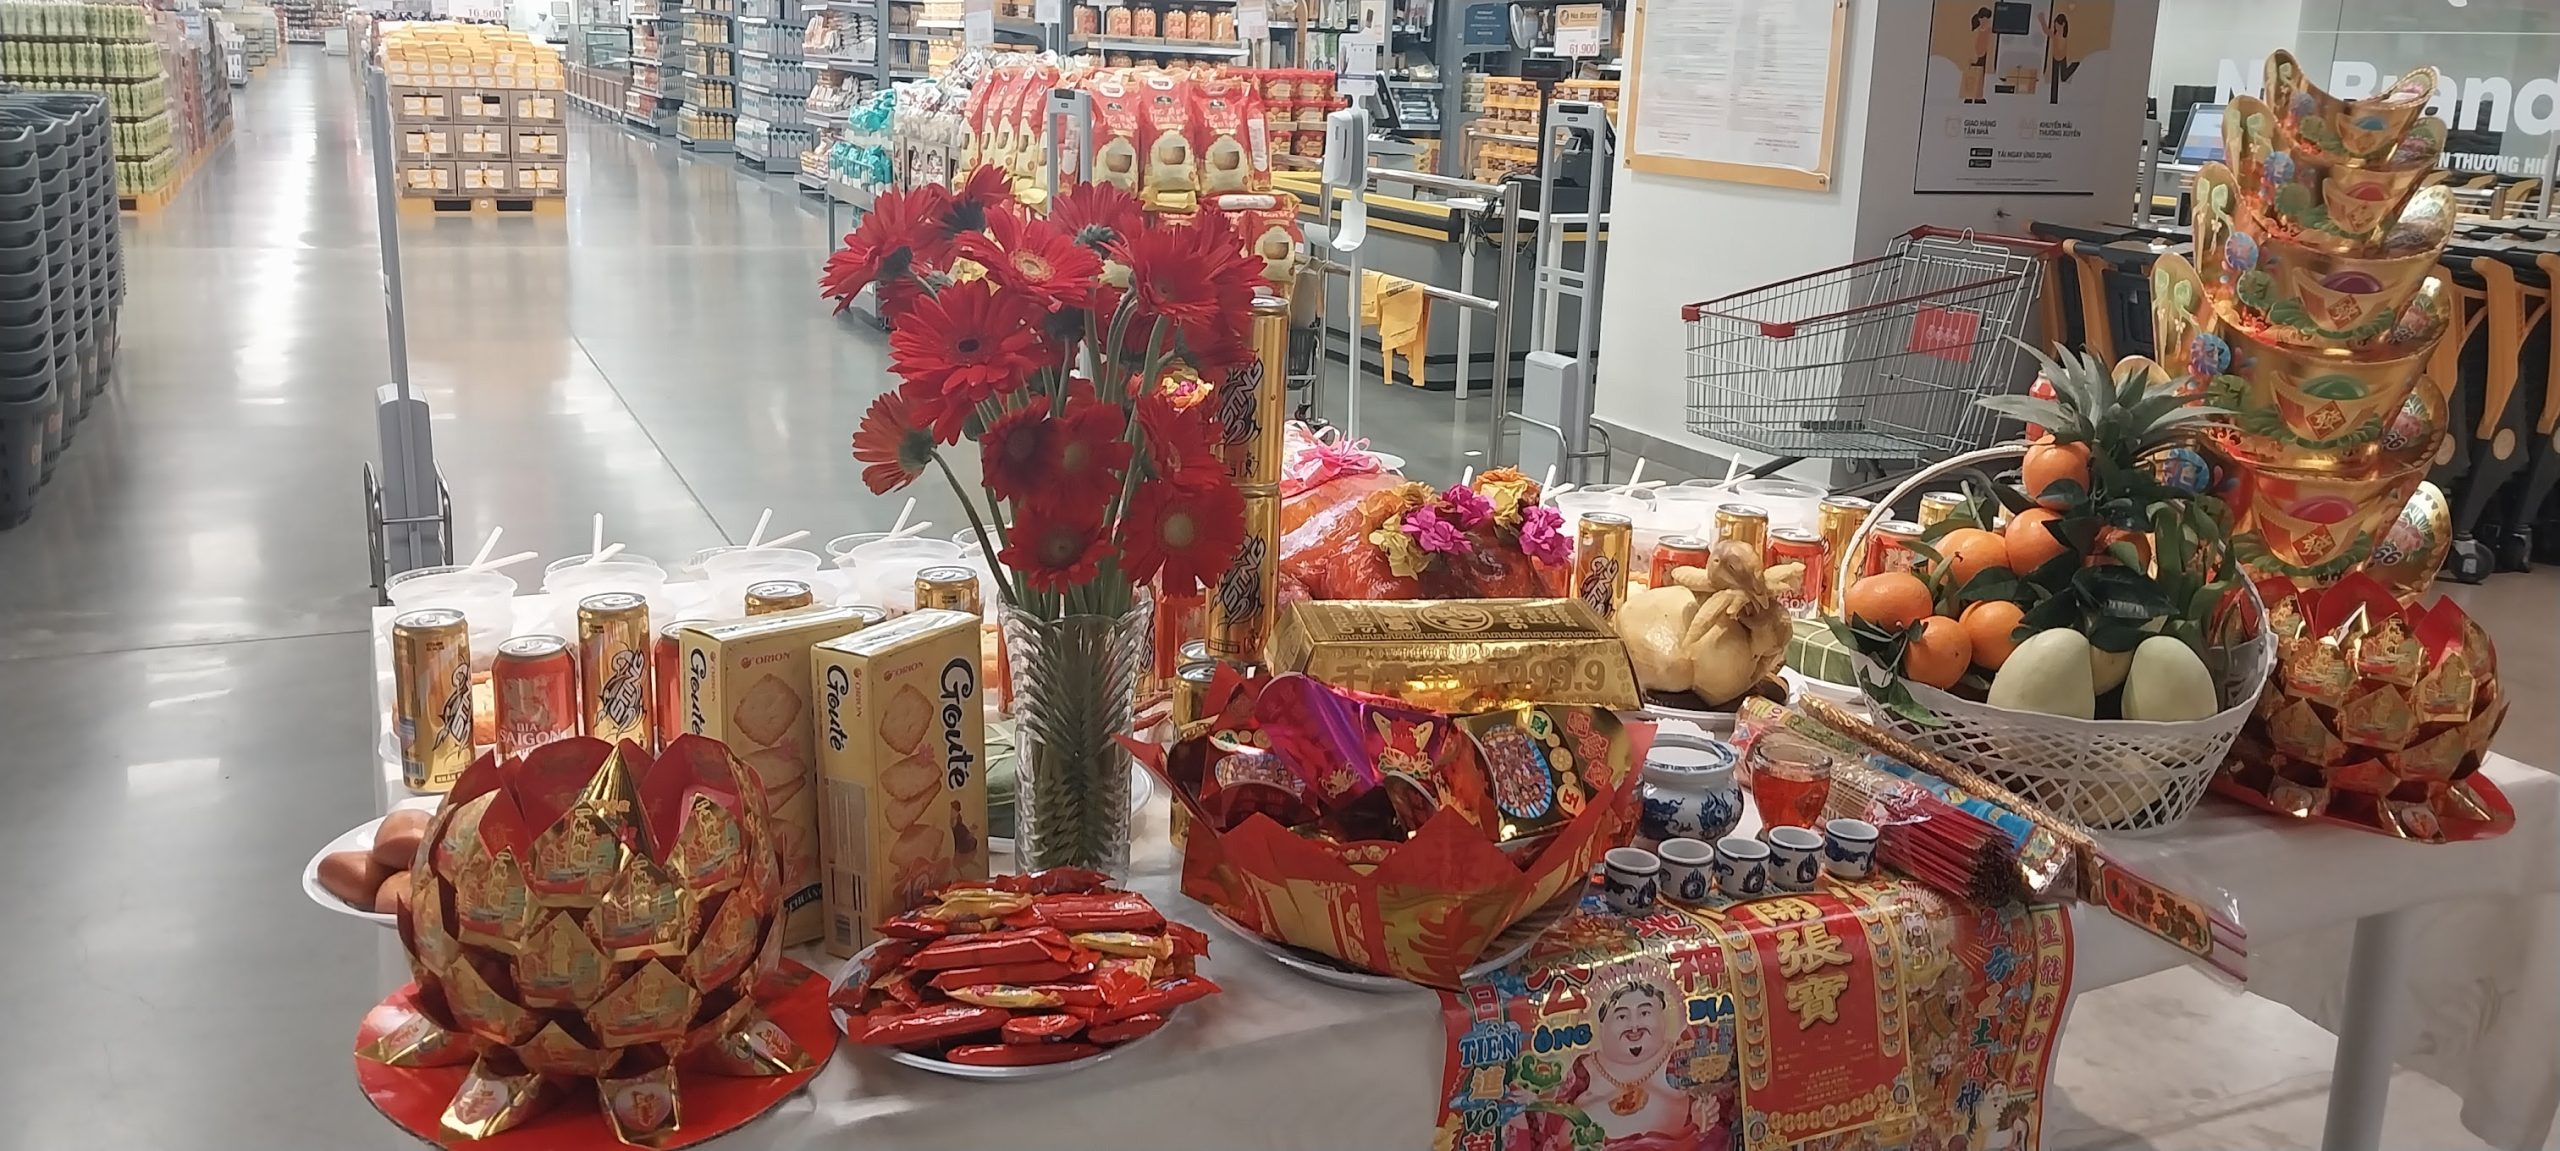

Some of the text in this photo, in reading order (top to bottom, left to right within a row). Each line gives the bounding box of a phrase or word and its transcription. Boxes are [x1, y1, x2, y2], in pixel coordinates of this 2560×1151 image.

[754, 651, 791, 665] ORION
[895, 660, 924, 678] ORION
[825, 663, 849, 752] Gouté
[939, 656, 975, 791] Gouté
[1463, 1102, 1500, 1131] VÔ
